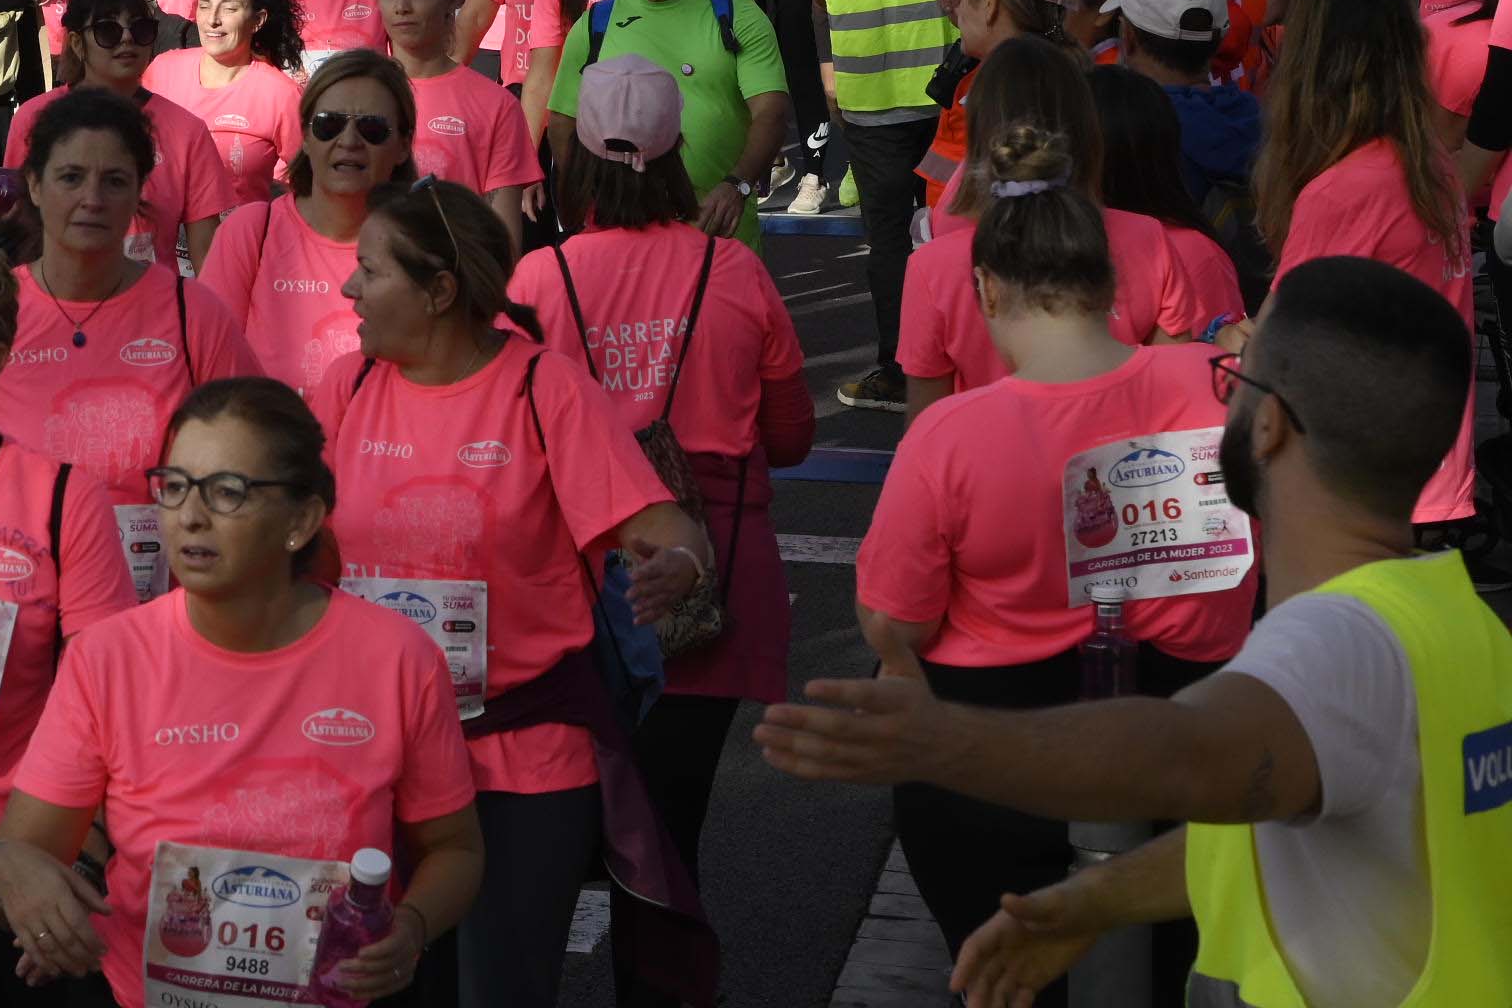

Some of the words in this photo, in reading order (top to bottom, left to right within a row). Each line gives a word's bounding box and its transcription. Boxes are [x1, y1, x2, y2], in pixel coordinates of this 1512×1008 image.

[274, 280, 329, 293] OYSHO
[605, 346, 638, 369] DE
[647, 341, 674, 365] LA
[1113, 464, 1180, 483] ASTURIANA
[1121, 497, 1182, 526] 016
[1130, 528, 1178, 547] 27213
[1087, 556, 1135, 571] CARRERA
[1137, 552, 1151, 562] DE
[1153, 550, 1167, 560] LA
[1169, 547, 1205, 558] MUJER
[1209, 544, 1233, 554] 2023
[1183, 567, 1240, 582] Santander
[443, 600, 474, 610] SUMA
[155, 722, 240, 746] OYSHO
[308, 721, 370, 738] ASTURIANA
[217, 880, 294, 902] ASTURIANA
[217, 921, 286, 952] 016
[226, 955, 270, 976] 9488
[166, 972, 221, 990] CARRERA
[223, 979, 241, 993] DE
[242, 982, 258, 994] LA
